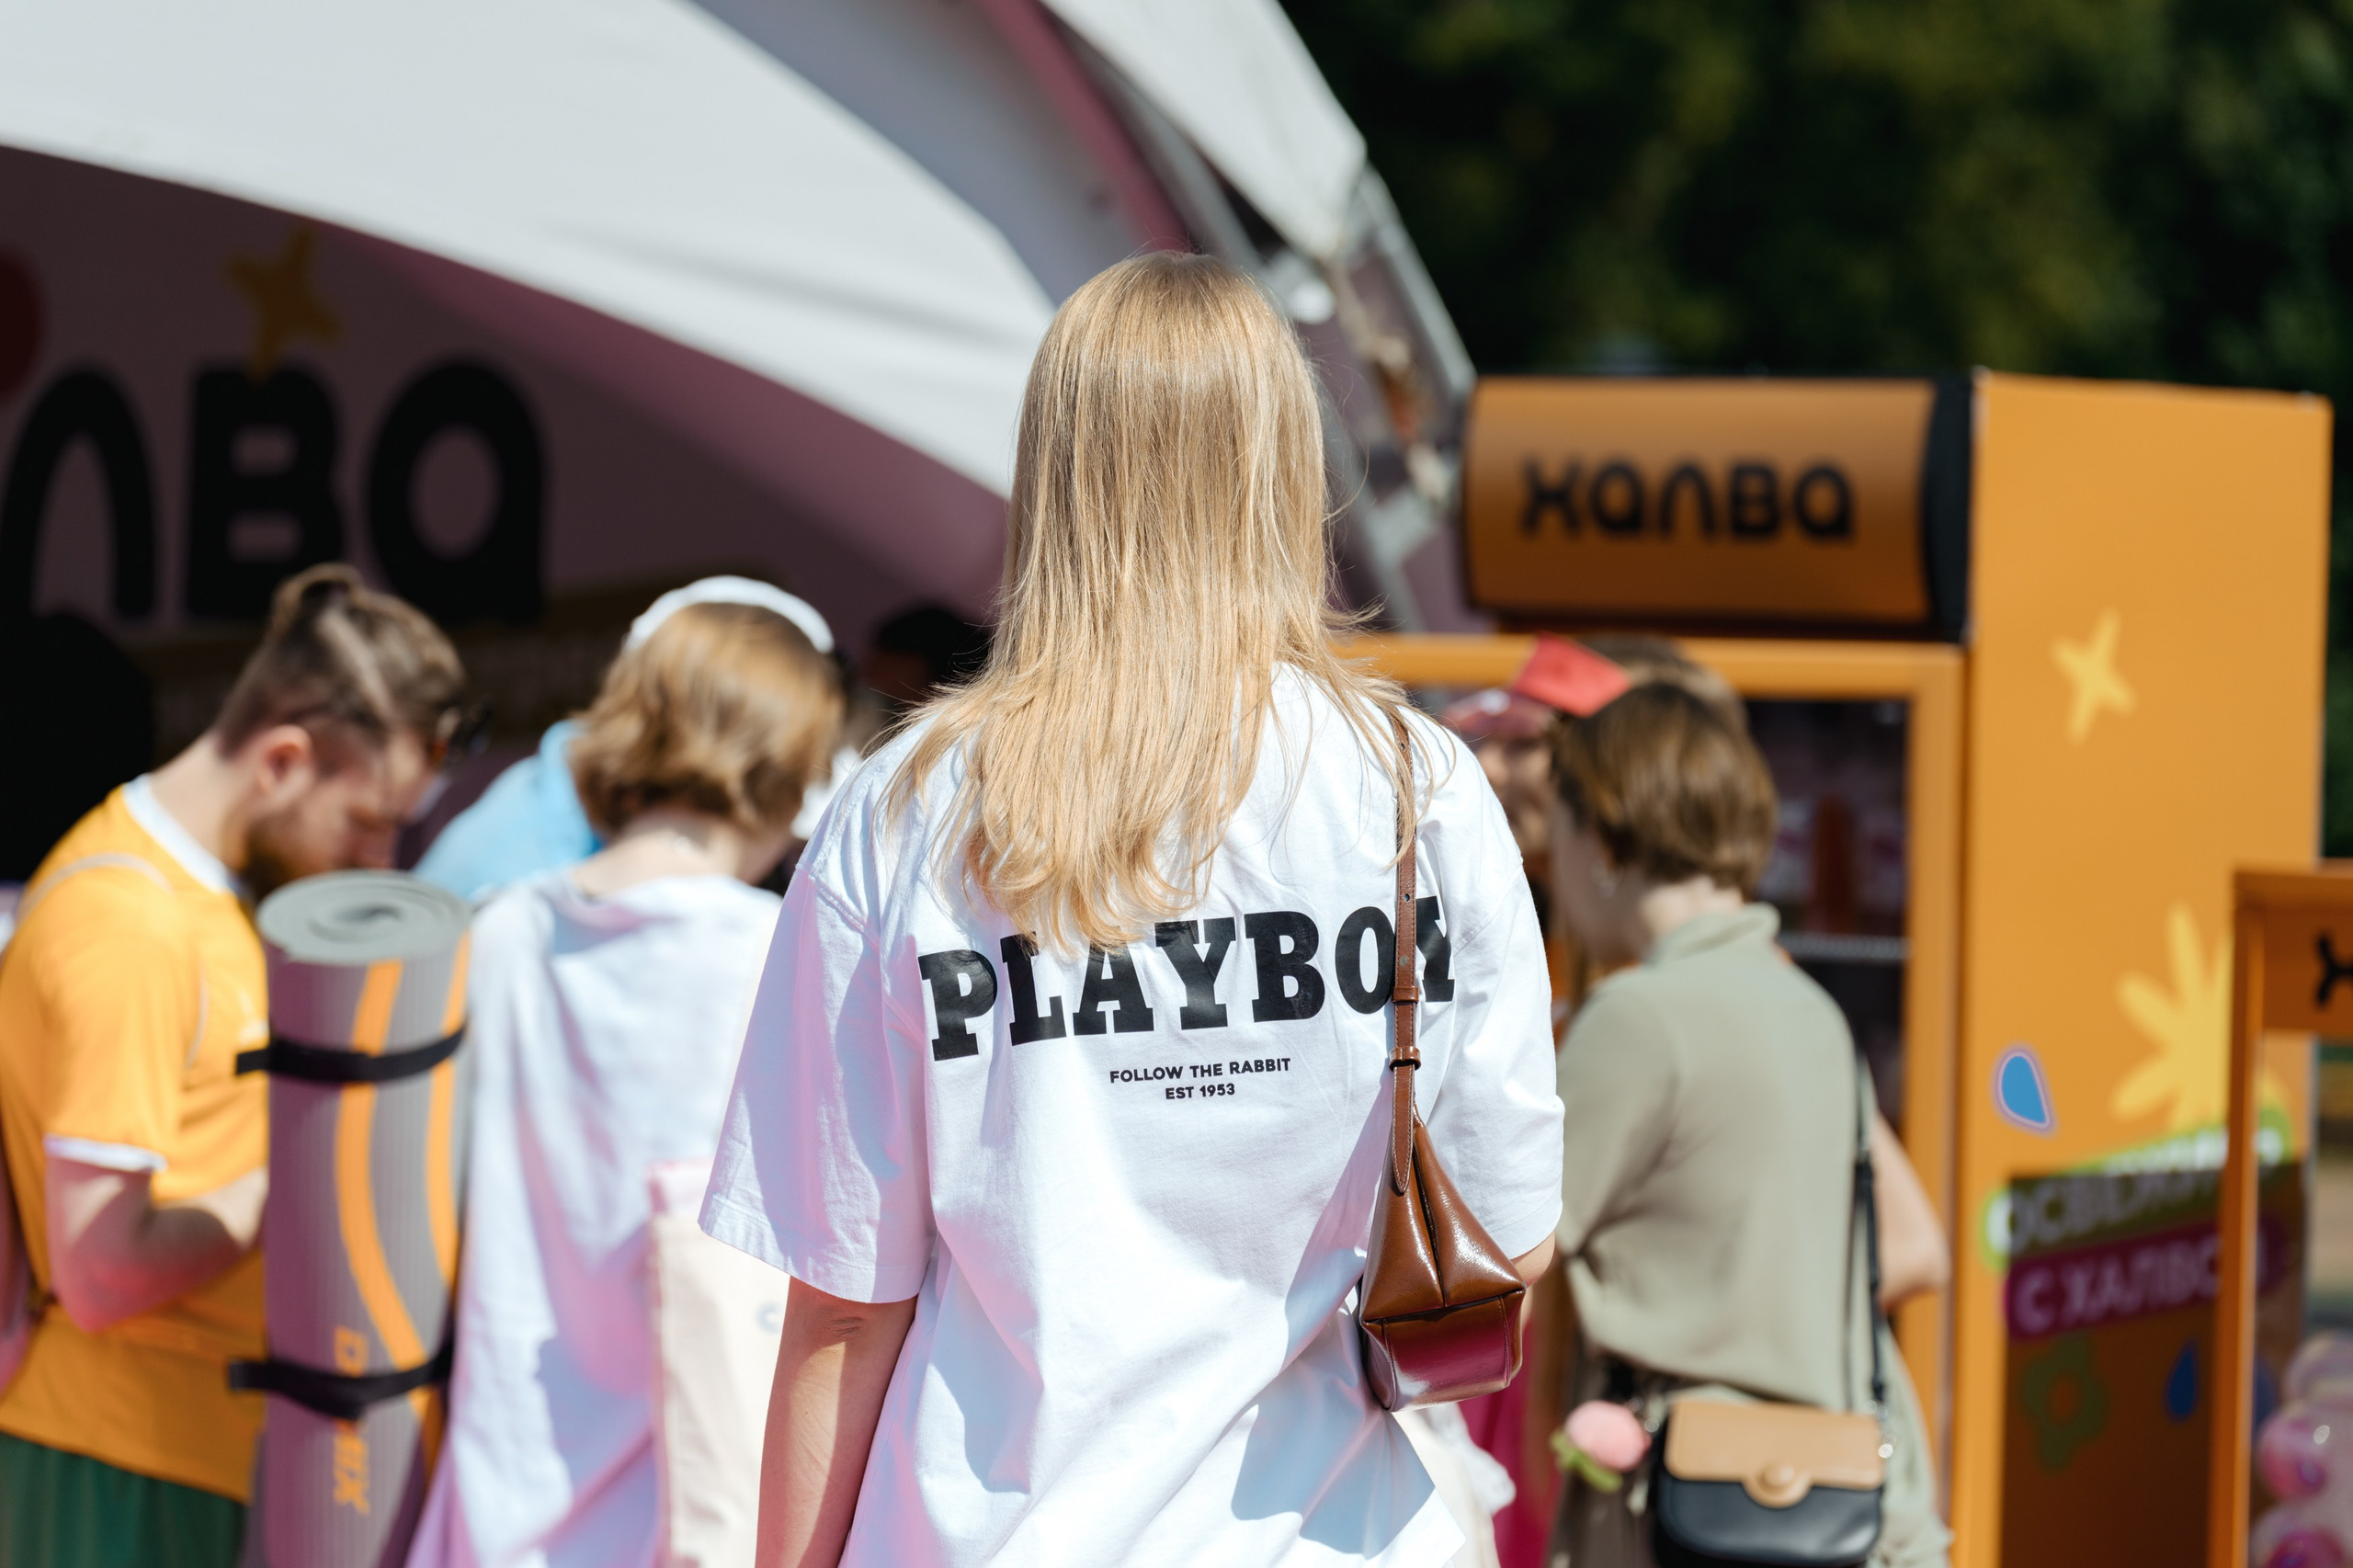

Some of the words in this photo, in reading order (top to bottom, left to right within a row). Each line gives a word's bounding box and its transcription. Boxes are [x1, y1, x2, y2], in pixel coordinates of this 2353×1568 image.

[917, 896, 1455, 1061] PLAYBOY
[1109, 1065, 1183, 1084] FOLLOW
[1189, 1063, 1222, 1078] THE
[1229, 1058, 1290, 1075] RABBIT
[1165, 1086, 1194, 1099] EST
[1199, 1083, 1235, 1097] 1953
